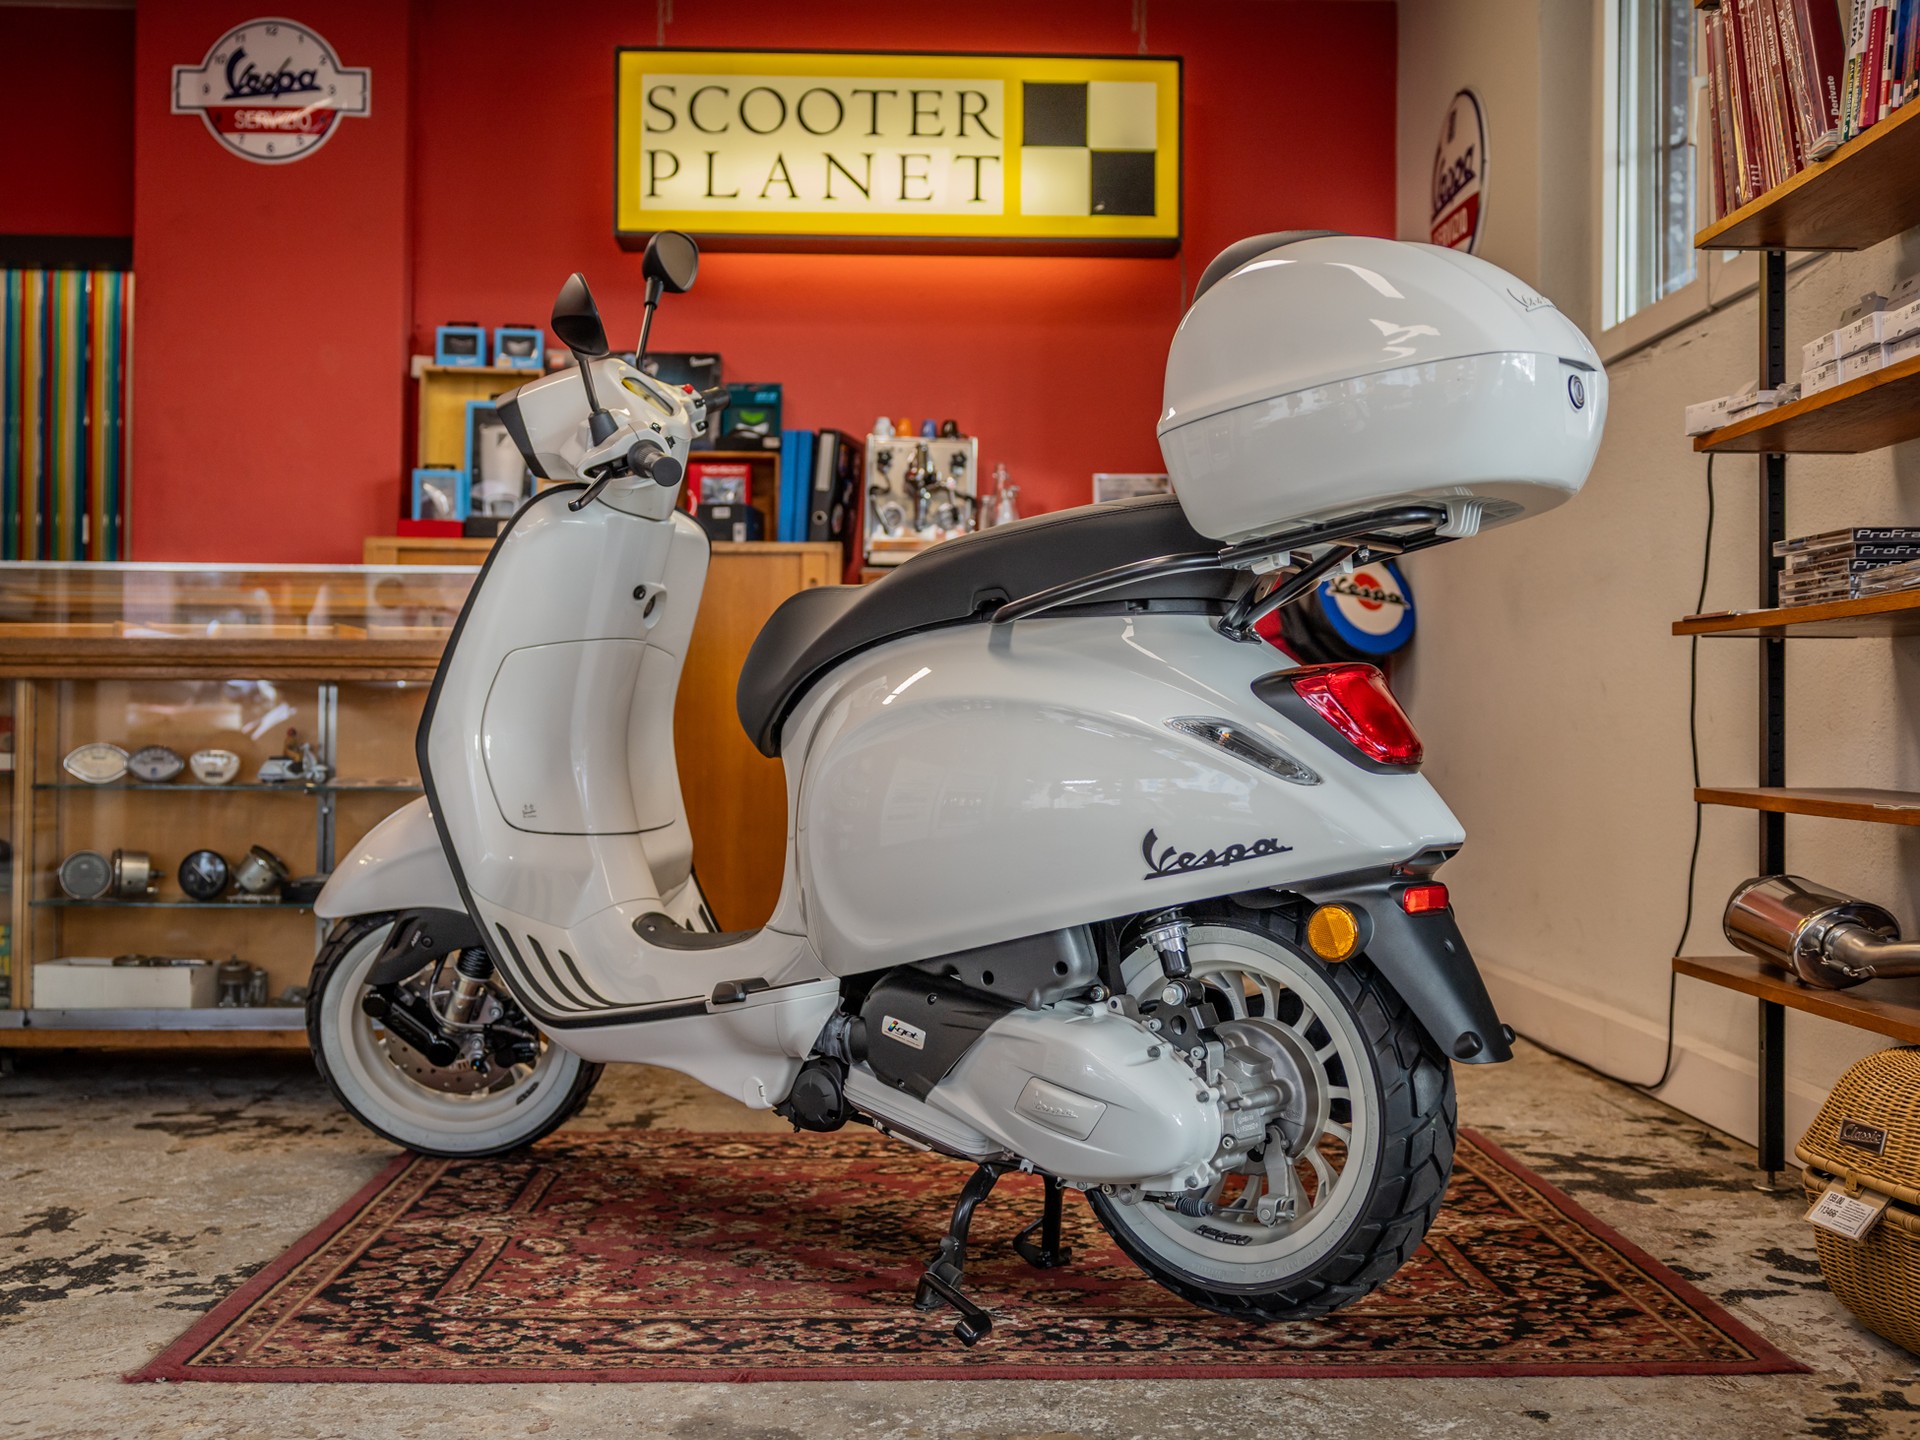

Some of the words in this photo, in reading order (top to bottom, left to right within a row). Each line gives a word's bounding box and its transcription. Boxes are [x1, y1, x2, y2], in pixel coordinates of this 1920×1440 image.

[1857, 0, 1866, 42] ESPA
[222, 46, 323, 100] Vespa
[233, 109, 313, 130] SERVIZIO
[644, 84, 1001, 140] SCOOTER
[644, 149, 1001, 204] PLANET
[1327, 577, 1409, 609] Vespa
[1142, 828, 1294, 880] Vespa
[1842, 1124, 1882, 1144] Classic
